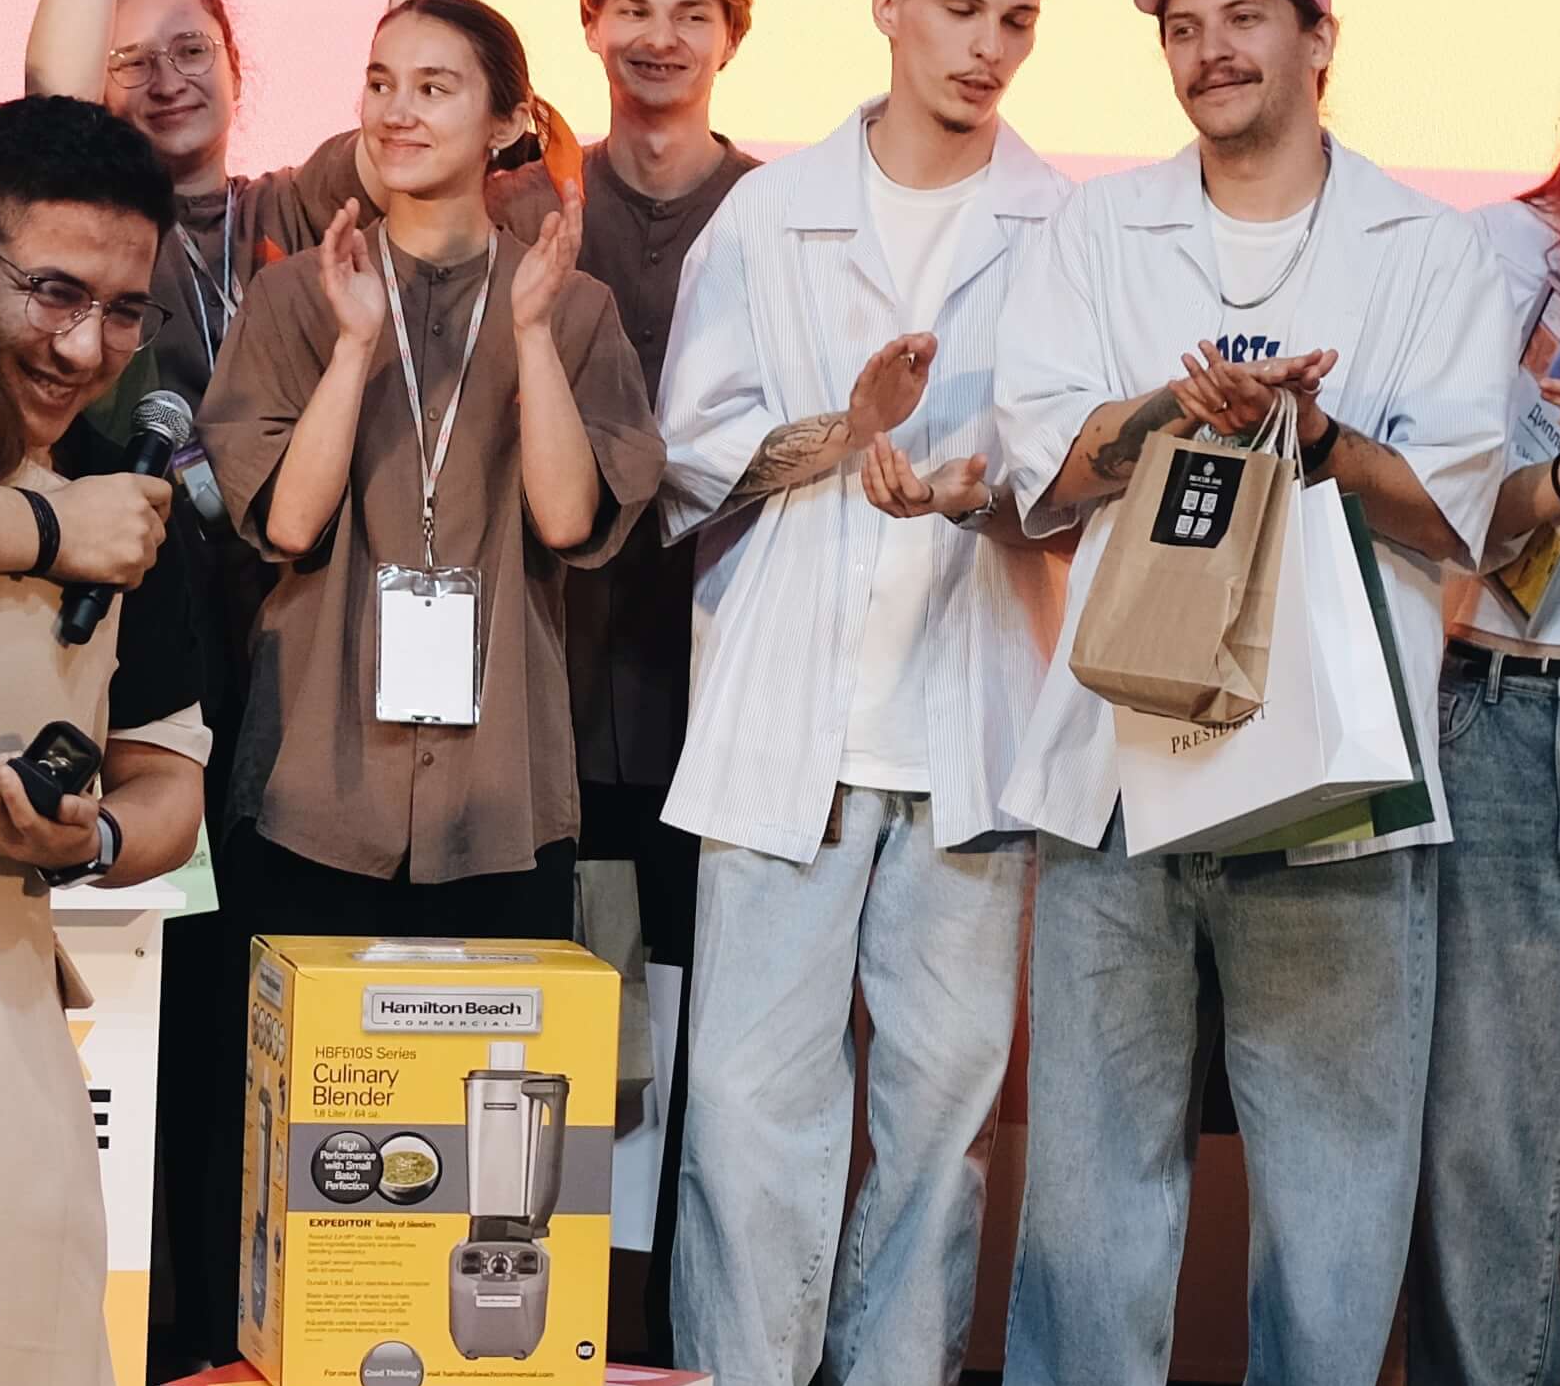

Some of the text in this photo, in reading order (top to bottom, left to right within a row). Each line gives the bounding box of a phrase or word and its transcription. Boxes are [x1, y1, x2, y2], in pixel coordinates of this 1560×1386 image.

[380, 1001, 521, 1015] Hamilton Beach
[315, 1046, 417, 1060] HBF510S Series
[313, 1063, 399, 1088] Culinary
[313, 1085, 395, 1106] Blender
[338, 1141, 359, 1152] High
[320, 1150, 377, 1161] Performance
[324, 1161, 371, 1170] with Small
[335, 1171, 361, 1181] Batch
[325, 1180, 370, 1191] Perfection
[309, 1219, 371, 1227] EXPEDITOR
